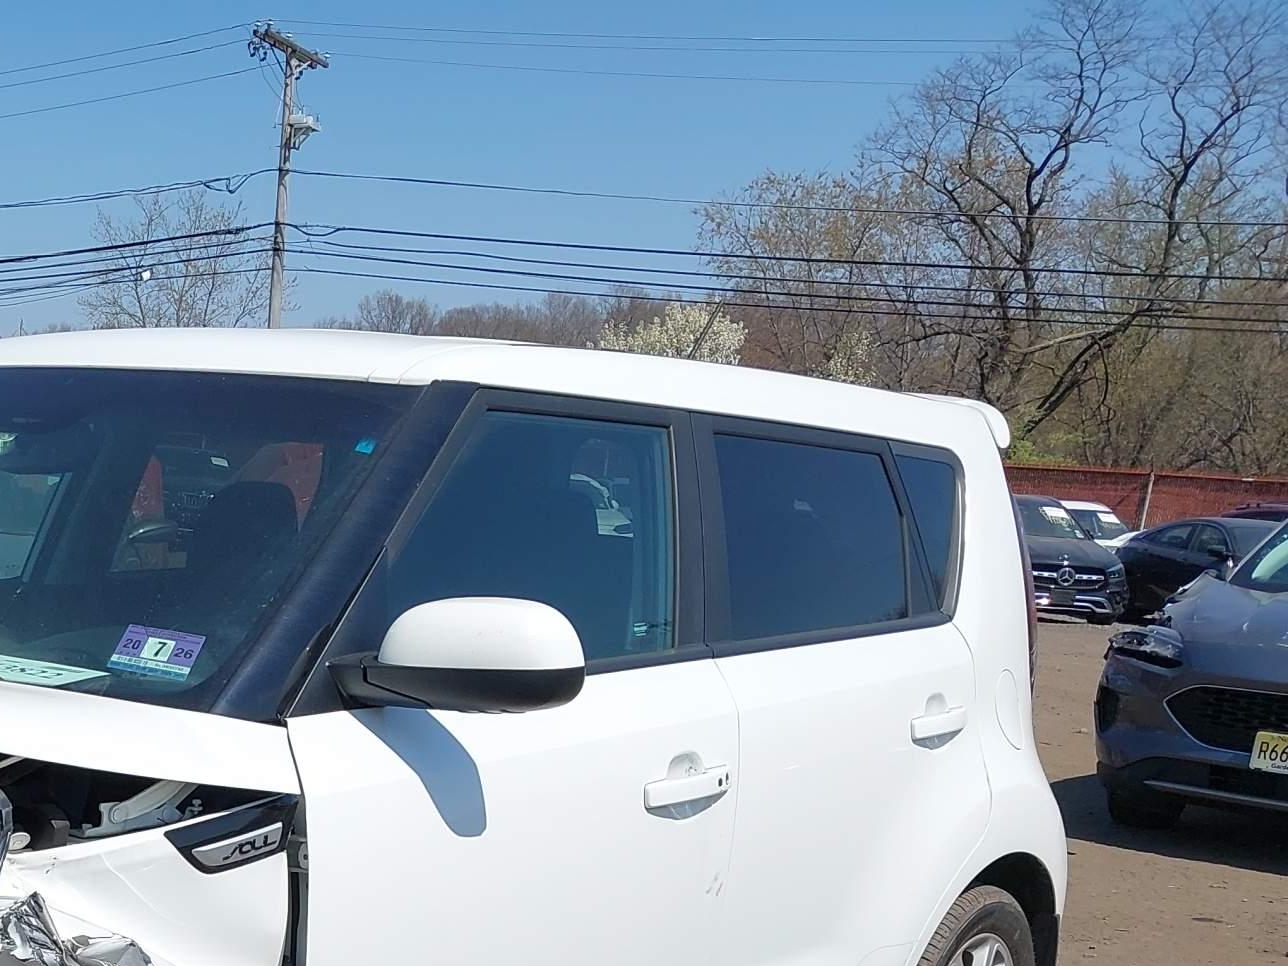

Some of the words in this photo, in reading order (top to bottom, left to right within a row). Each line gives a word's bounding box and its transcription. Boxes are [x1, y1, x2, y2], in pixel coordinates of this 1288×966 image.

[122, 638, 142, 650] 20
[152, 641, 168, 658] 7
[172, 647, 194, 660] 26
[222, 834, 279, 862] SOUL
